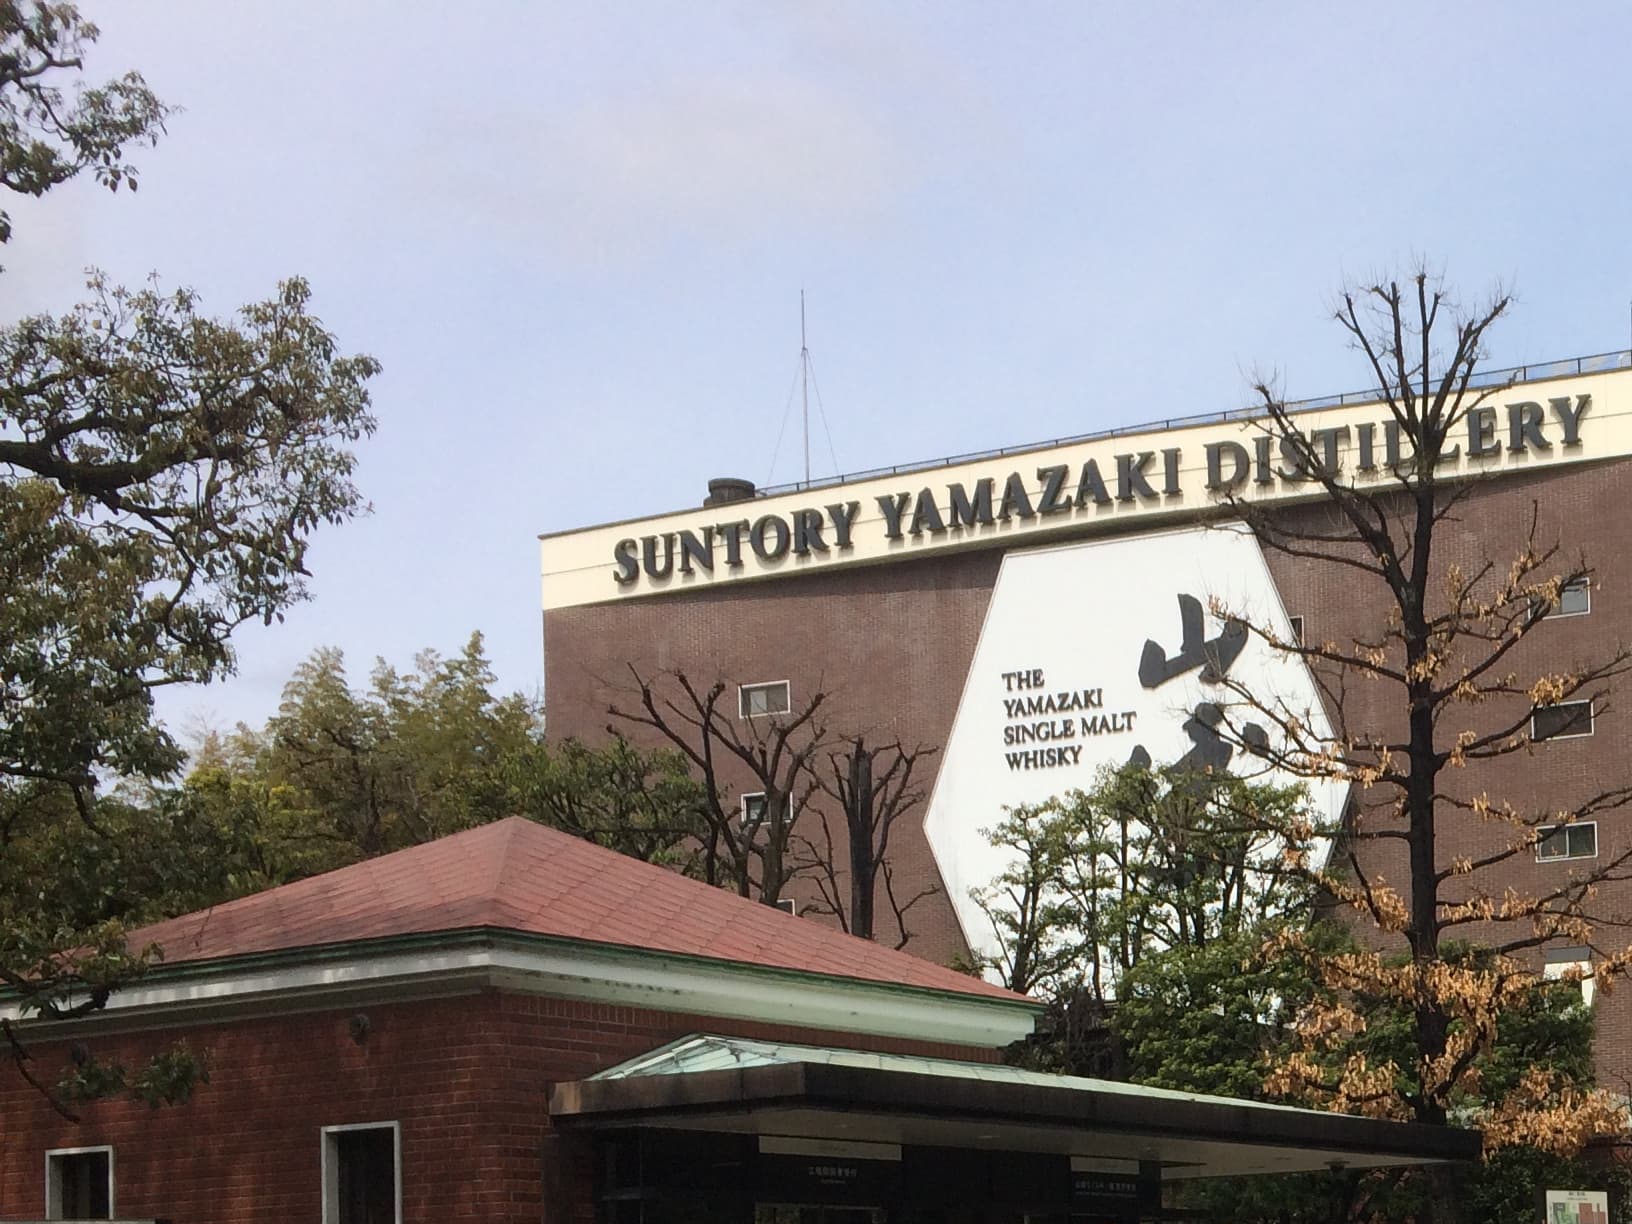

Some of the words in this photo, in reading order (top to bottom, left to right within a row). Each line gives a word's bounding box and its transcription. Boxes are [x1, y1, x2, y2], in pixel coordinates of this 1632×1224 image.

[613, 500, 860, 585] SUNTORY
[875, 447, 1182, 539] YAMAZAKI
[1001, 668, 1045, 692] THE
[1003, 688, 1103, 717] YAMAZAKI
[1003, 719, 1076, 746] SINGLE
[1081, 711, 1137, 735] MALT
[1005, 745, 1083, 771] WHISKY
